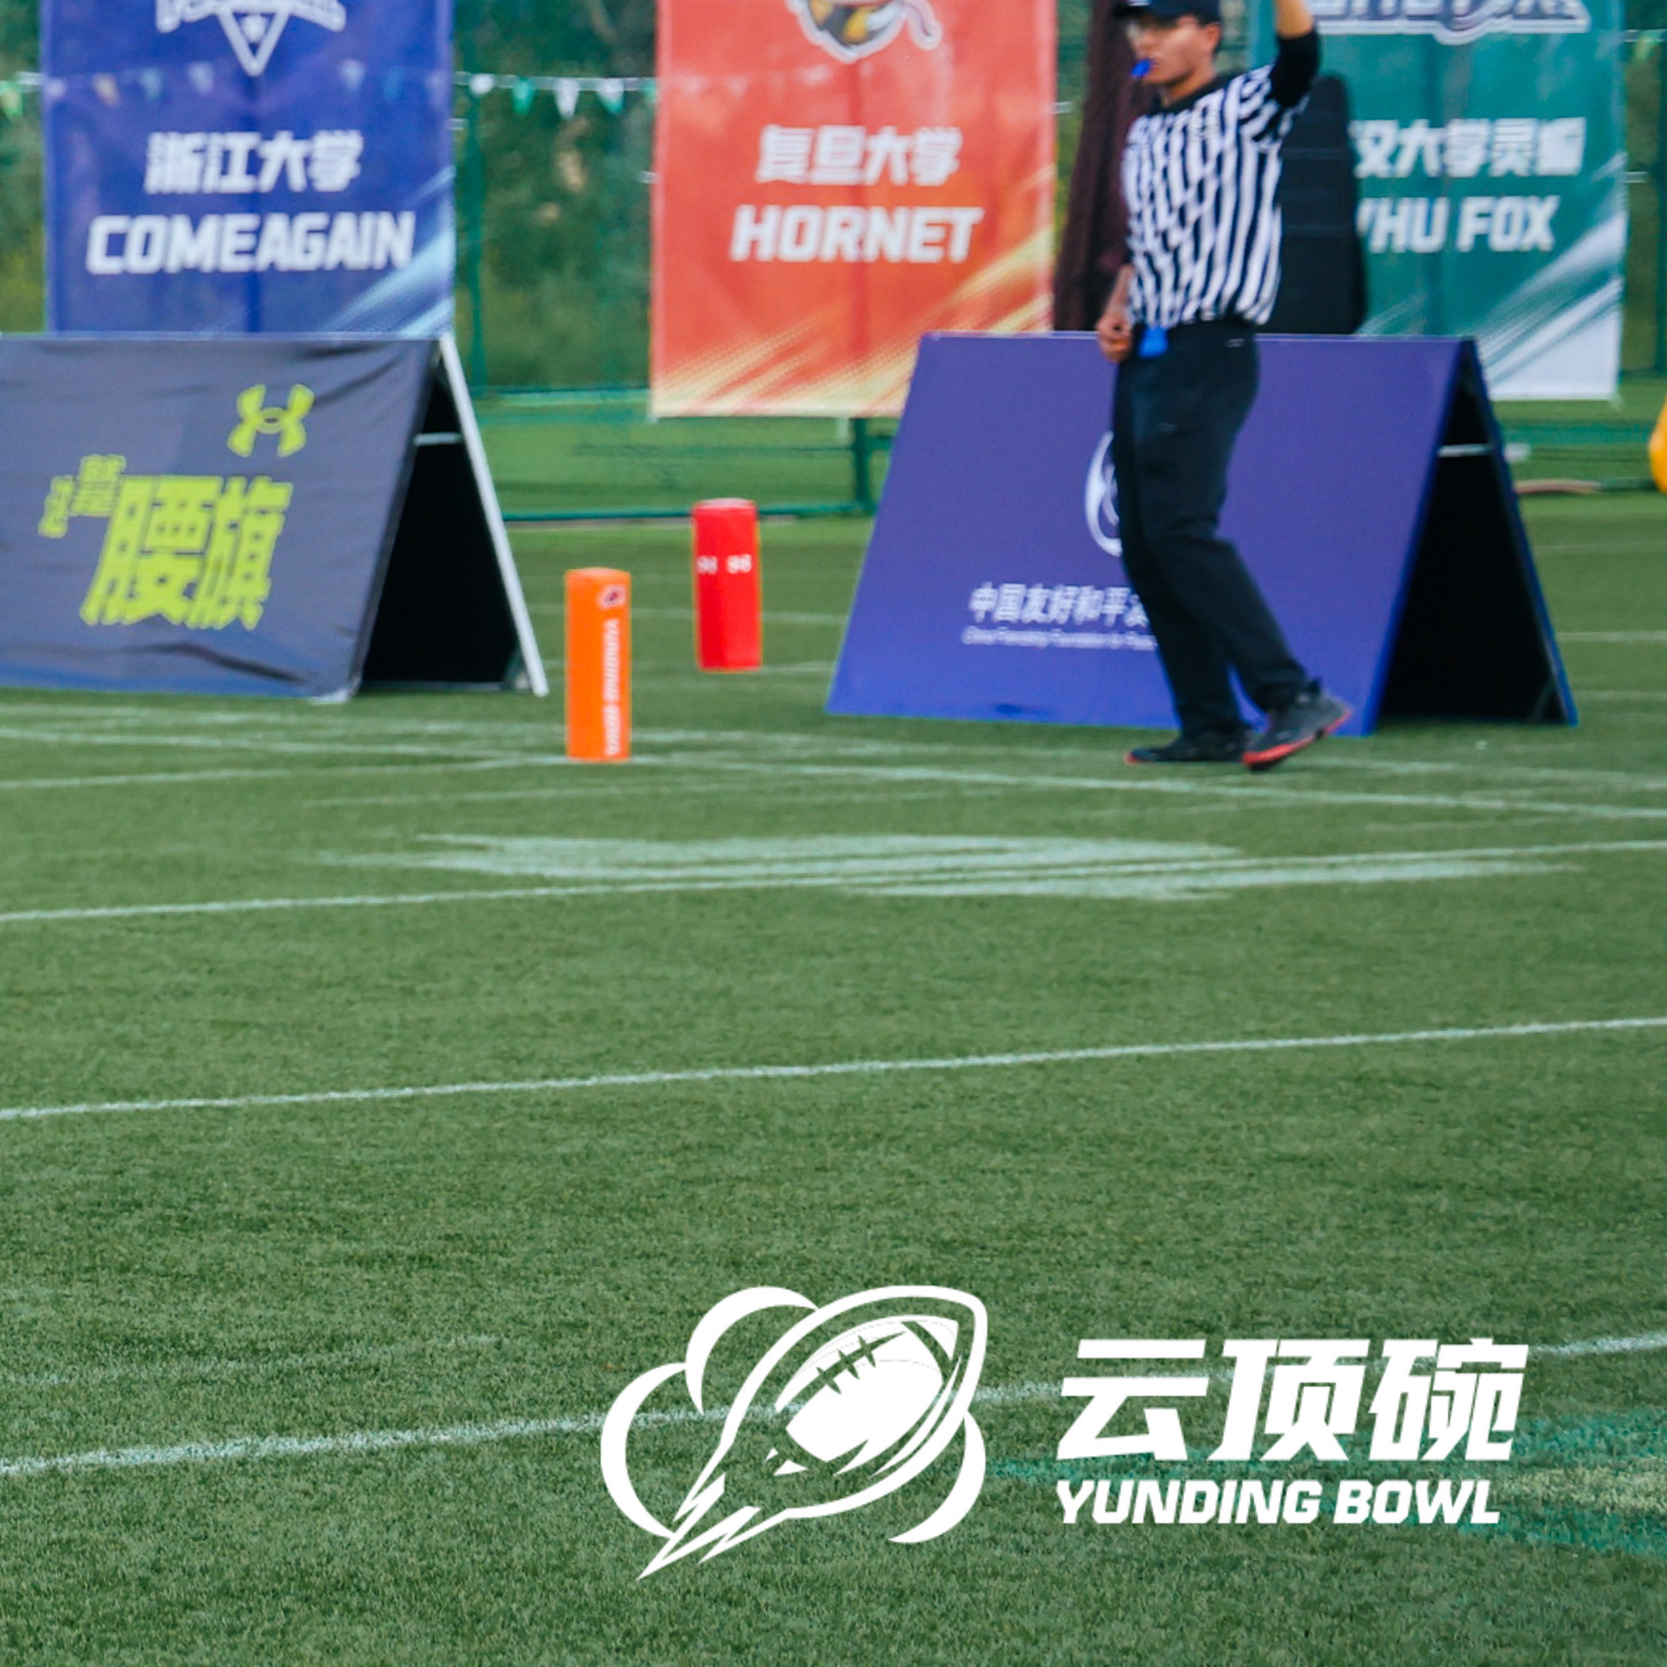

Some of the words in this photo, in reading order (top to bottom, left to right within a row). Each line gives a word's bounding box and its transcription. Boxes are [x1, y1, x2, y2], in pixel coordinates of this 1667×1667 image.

[143, 129, 364, 194] 浙江大学
[756, 124, 963, 186] 复旦大学
[85, 210, 416, 275] COMEAGAIN
[728, 204, 986, 263] HORNET
[1455, 195, 1562, 253] FOX
[78, 474, 293, 631] 腰旗
